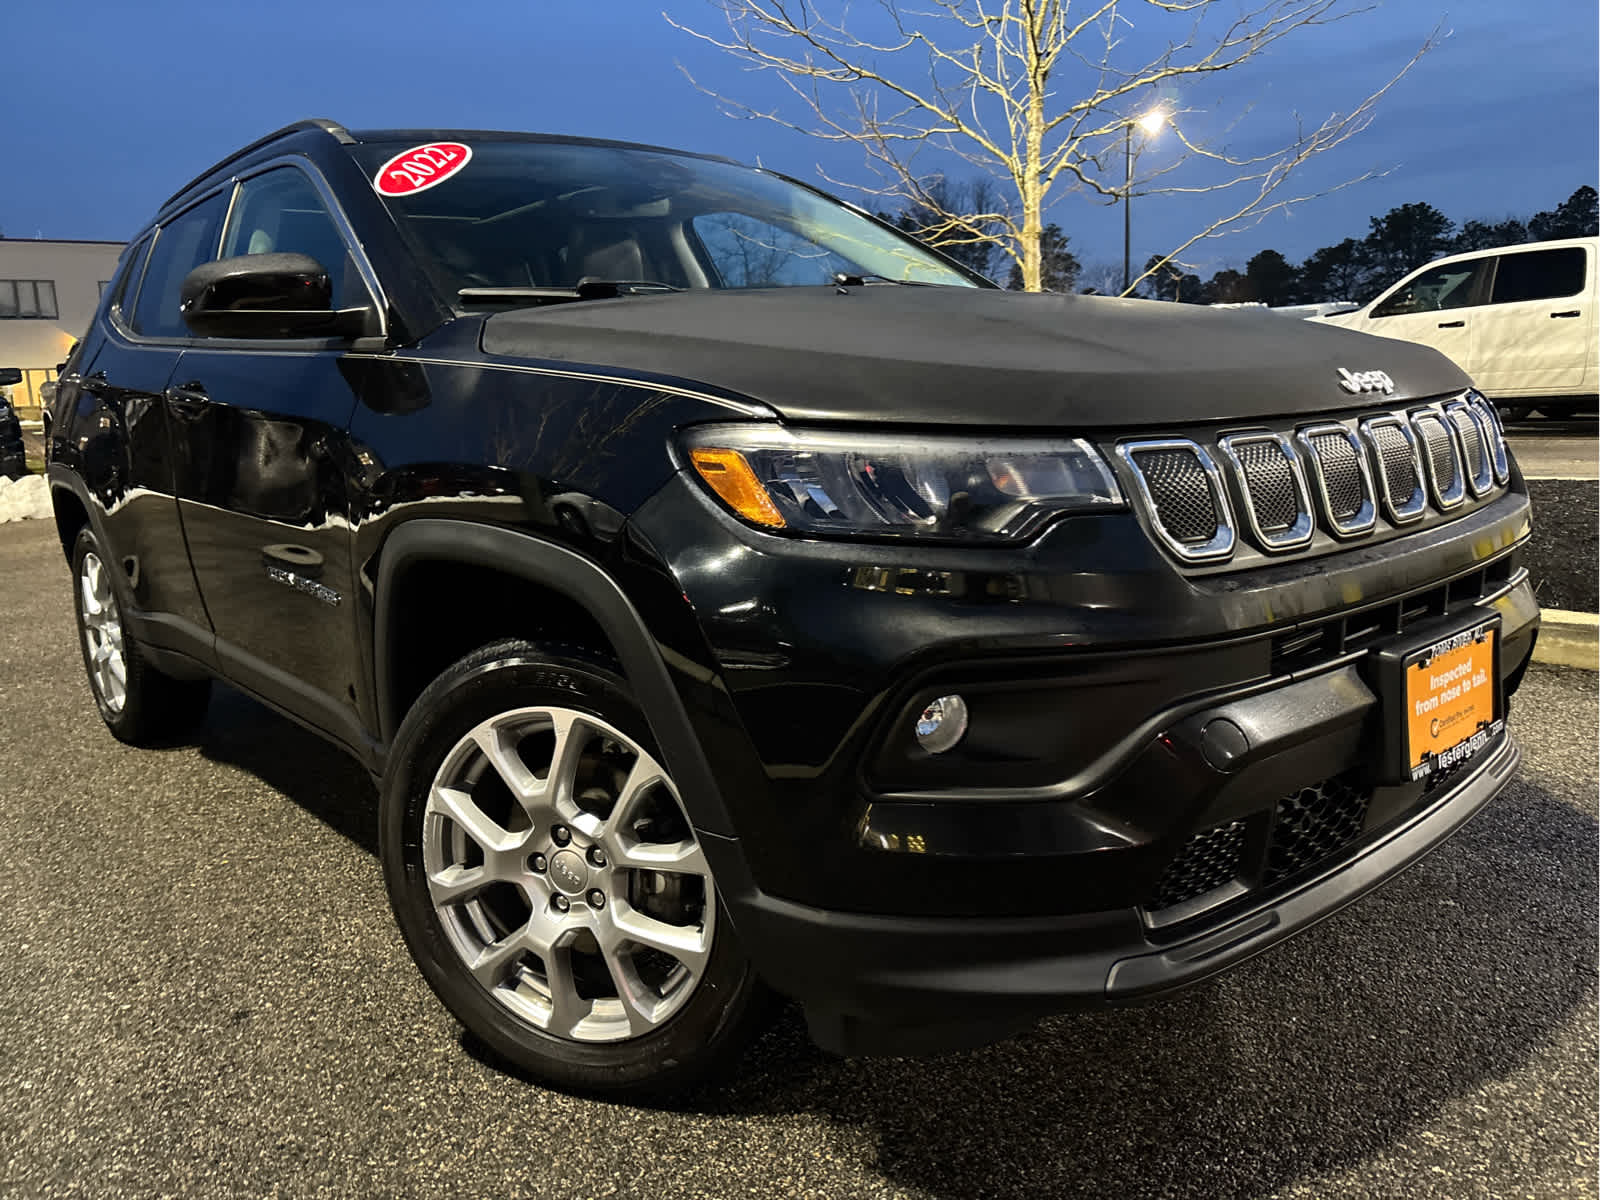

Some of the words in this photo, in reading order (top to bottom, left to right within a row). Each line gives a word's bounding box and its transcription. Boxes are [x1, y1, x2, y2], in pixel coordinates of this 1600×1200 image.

[390, 147, 458, 188] 2022
[1337, 367, 1394, 394] Jeep
[1416, 695, 1439, 717] from
[1440, 685, 1461, 705] nose
[1462, 679, 1471, 693] to
[1472, 668, 1488, 688] tail.
[1430, 657, 1472, 691] Inspected
